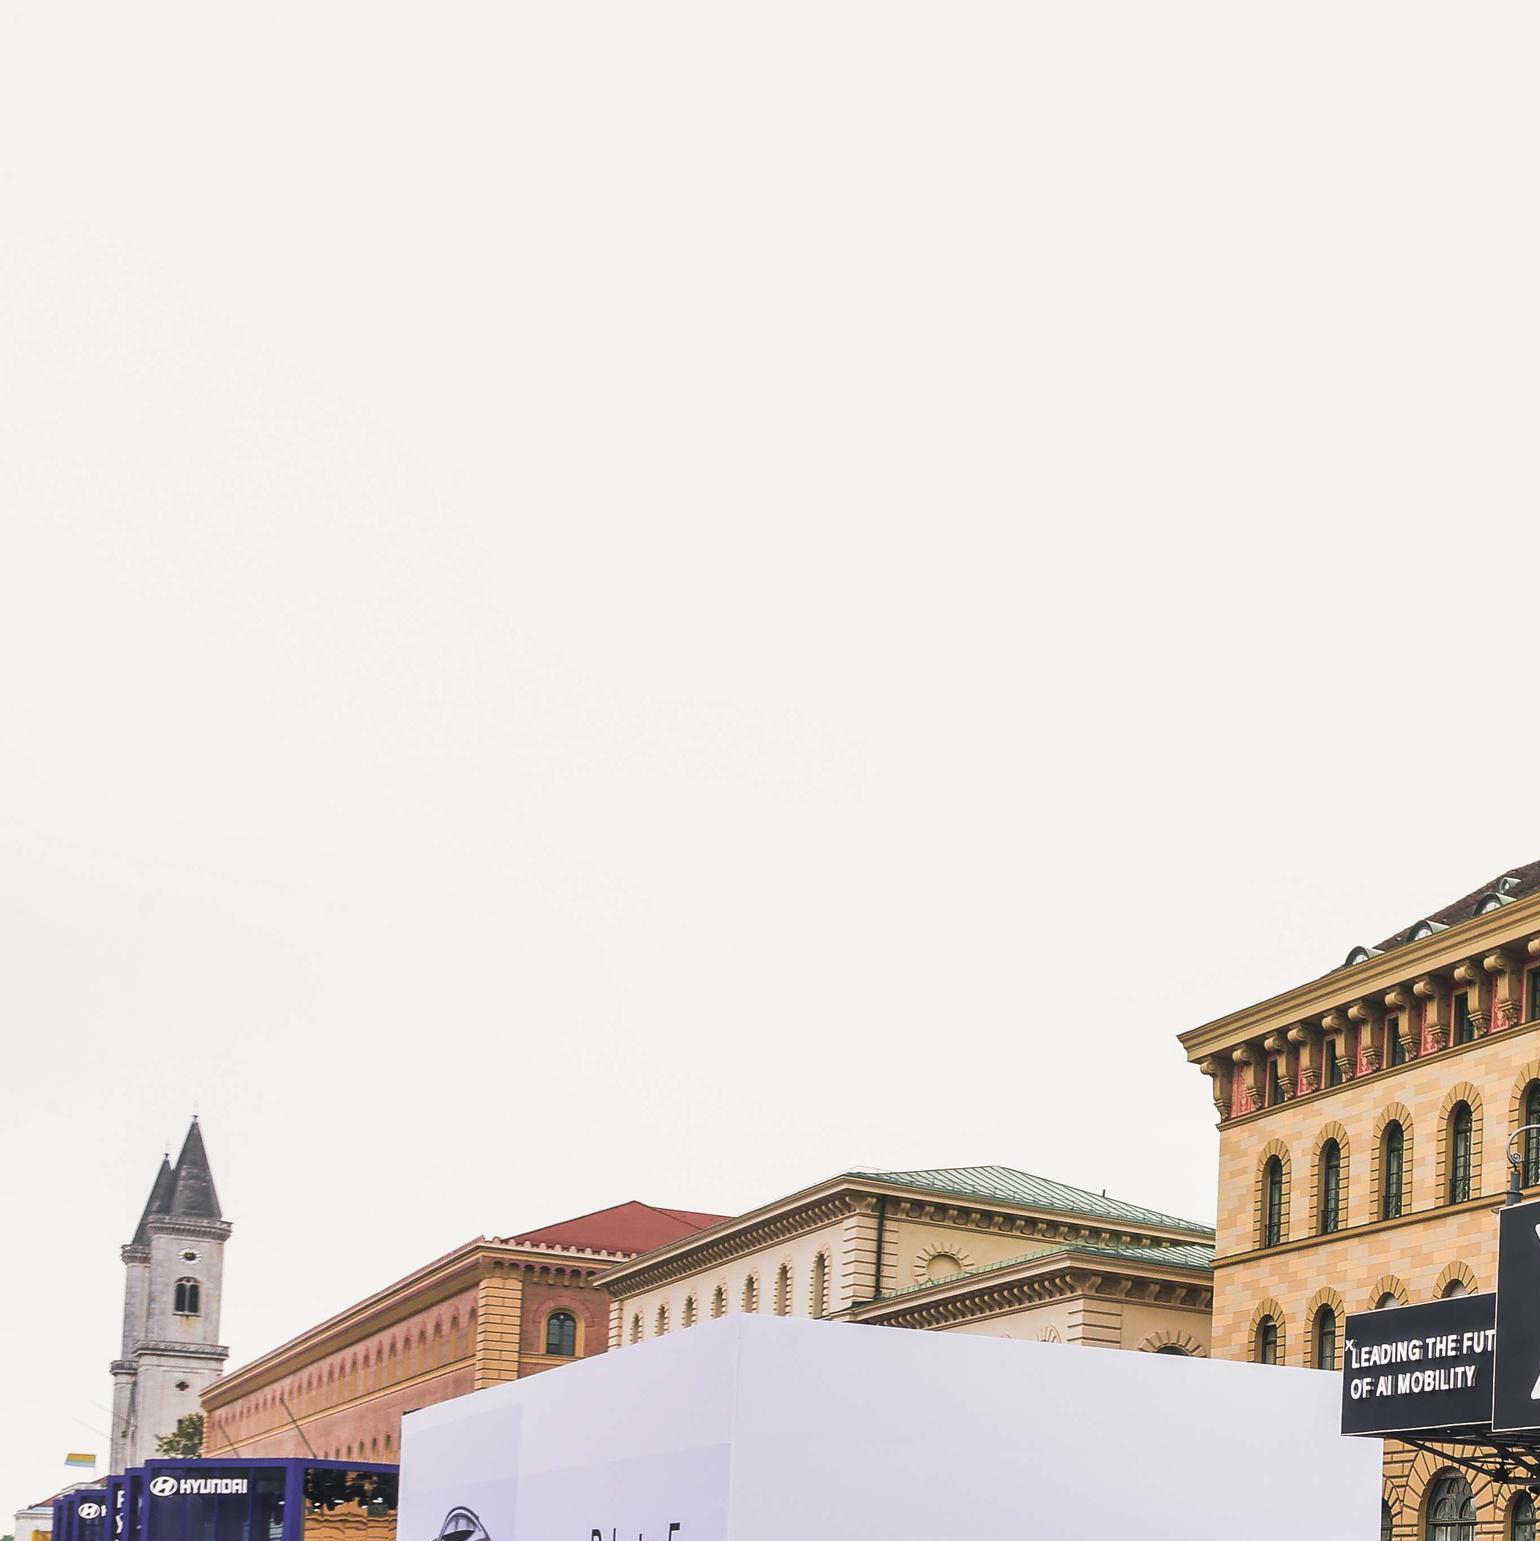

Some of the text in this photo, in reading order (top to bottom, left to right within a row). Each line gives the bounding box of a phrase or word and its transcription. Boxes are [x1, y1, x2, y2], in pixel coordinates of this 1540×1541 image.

[1351, 1339, 1423, 1369] LEADING
[1426, 1334, 1459, 1360] THE
[1350, 1364, 1477, 1400] OF AI MOBILITY
[180, 1478, 248, 1495] HYUNDAI
